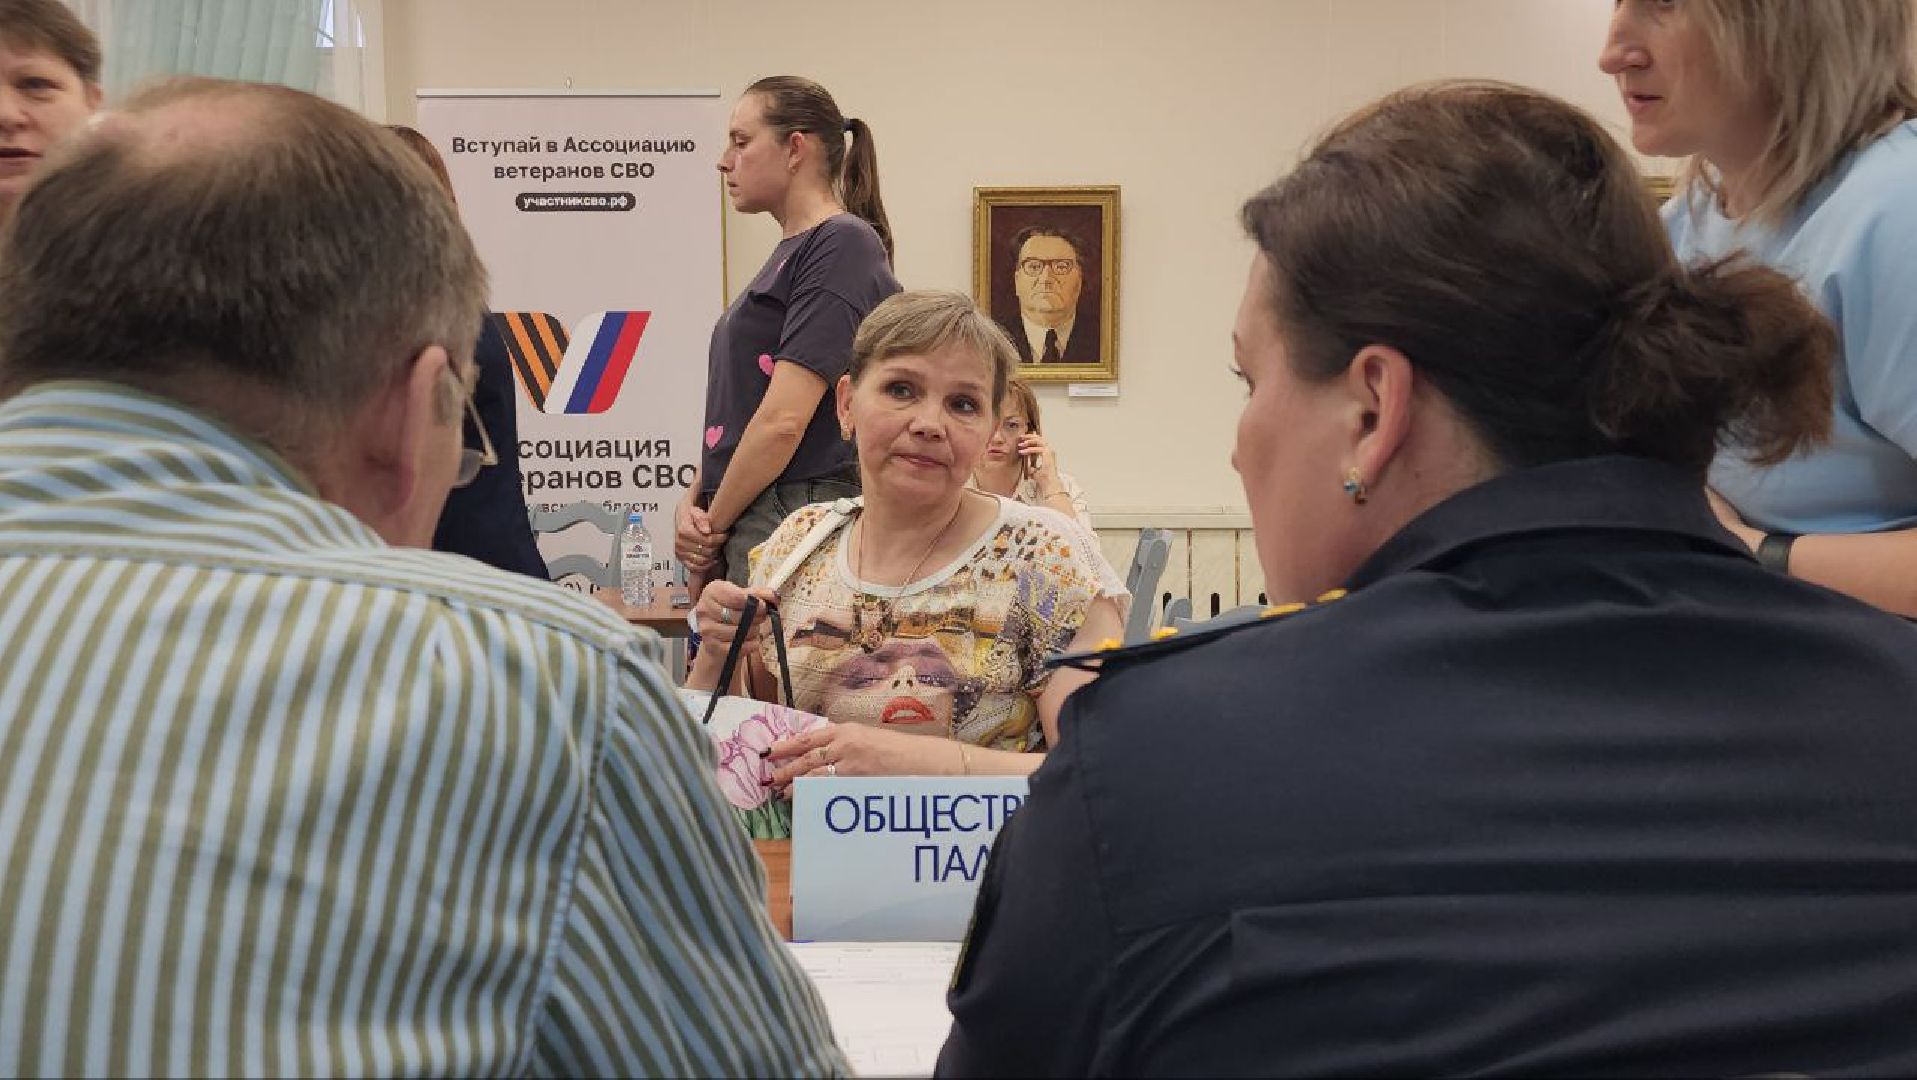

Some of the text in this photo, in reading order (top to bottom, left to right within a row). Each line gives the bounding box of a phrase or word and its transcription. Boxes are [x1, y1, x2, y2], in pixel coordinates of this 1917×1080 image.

[452, 136, 696, 157] Вступай в Ассоциацию
[494, 162, 655, 182] ветеранов СВО
[523, 195, 629, 209] участниксво.рф
[517, 439, 671, 462] социация
[632, 463, 697, 489] СВО
[824, 794, 1030, 839] ОБЩЕСТВ
